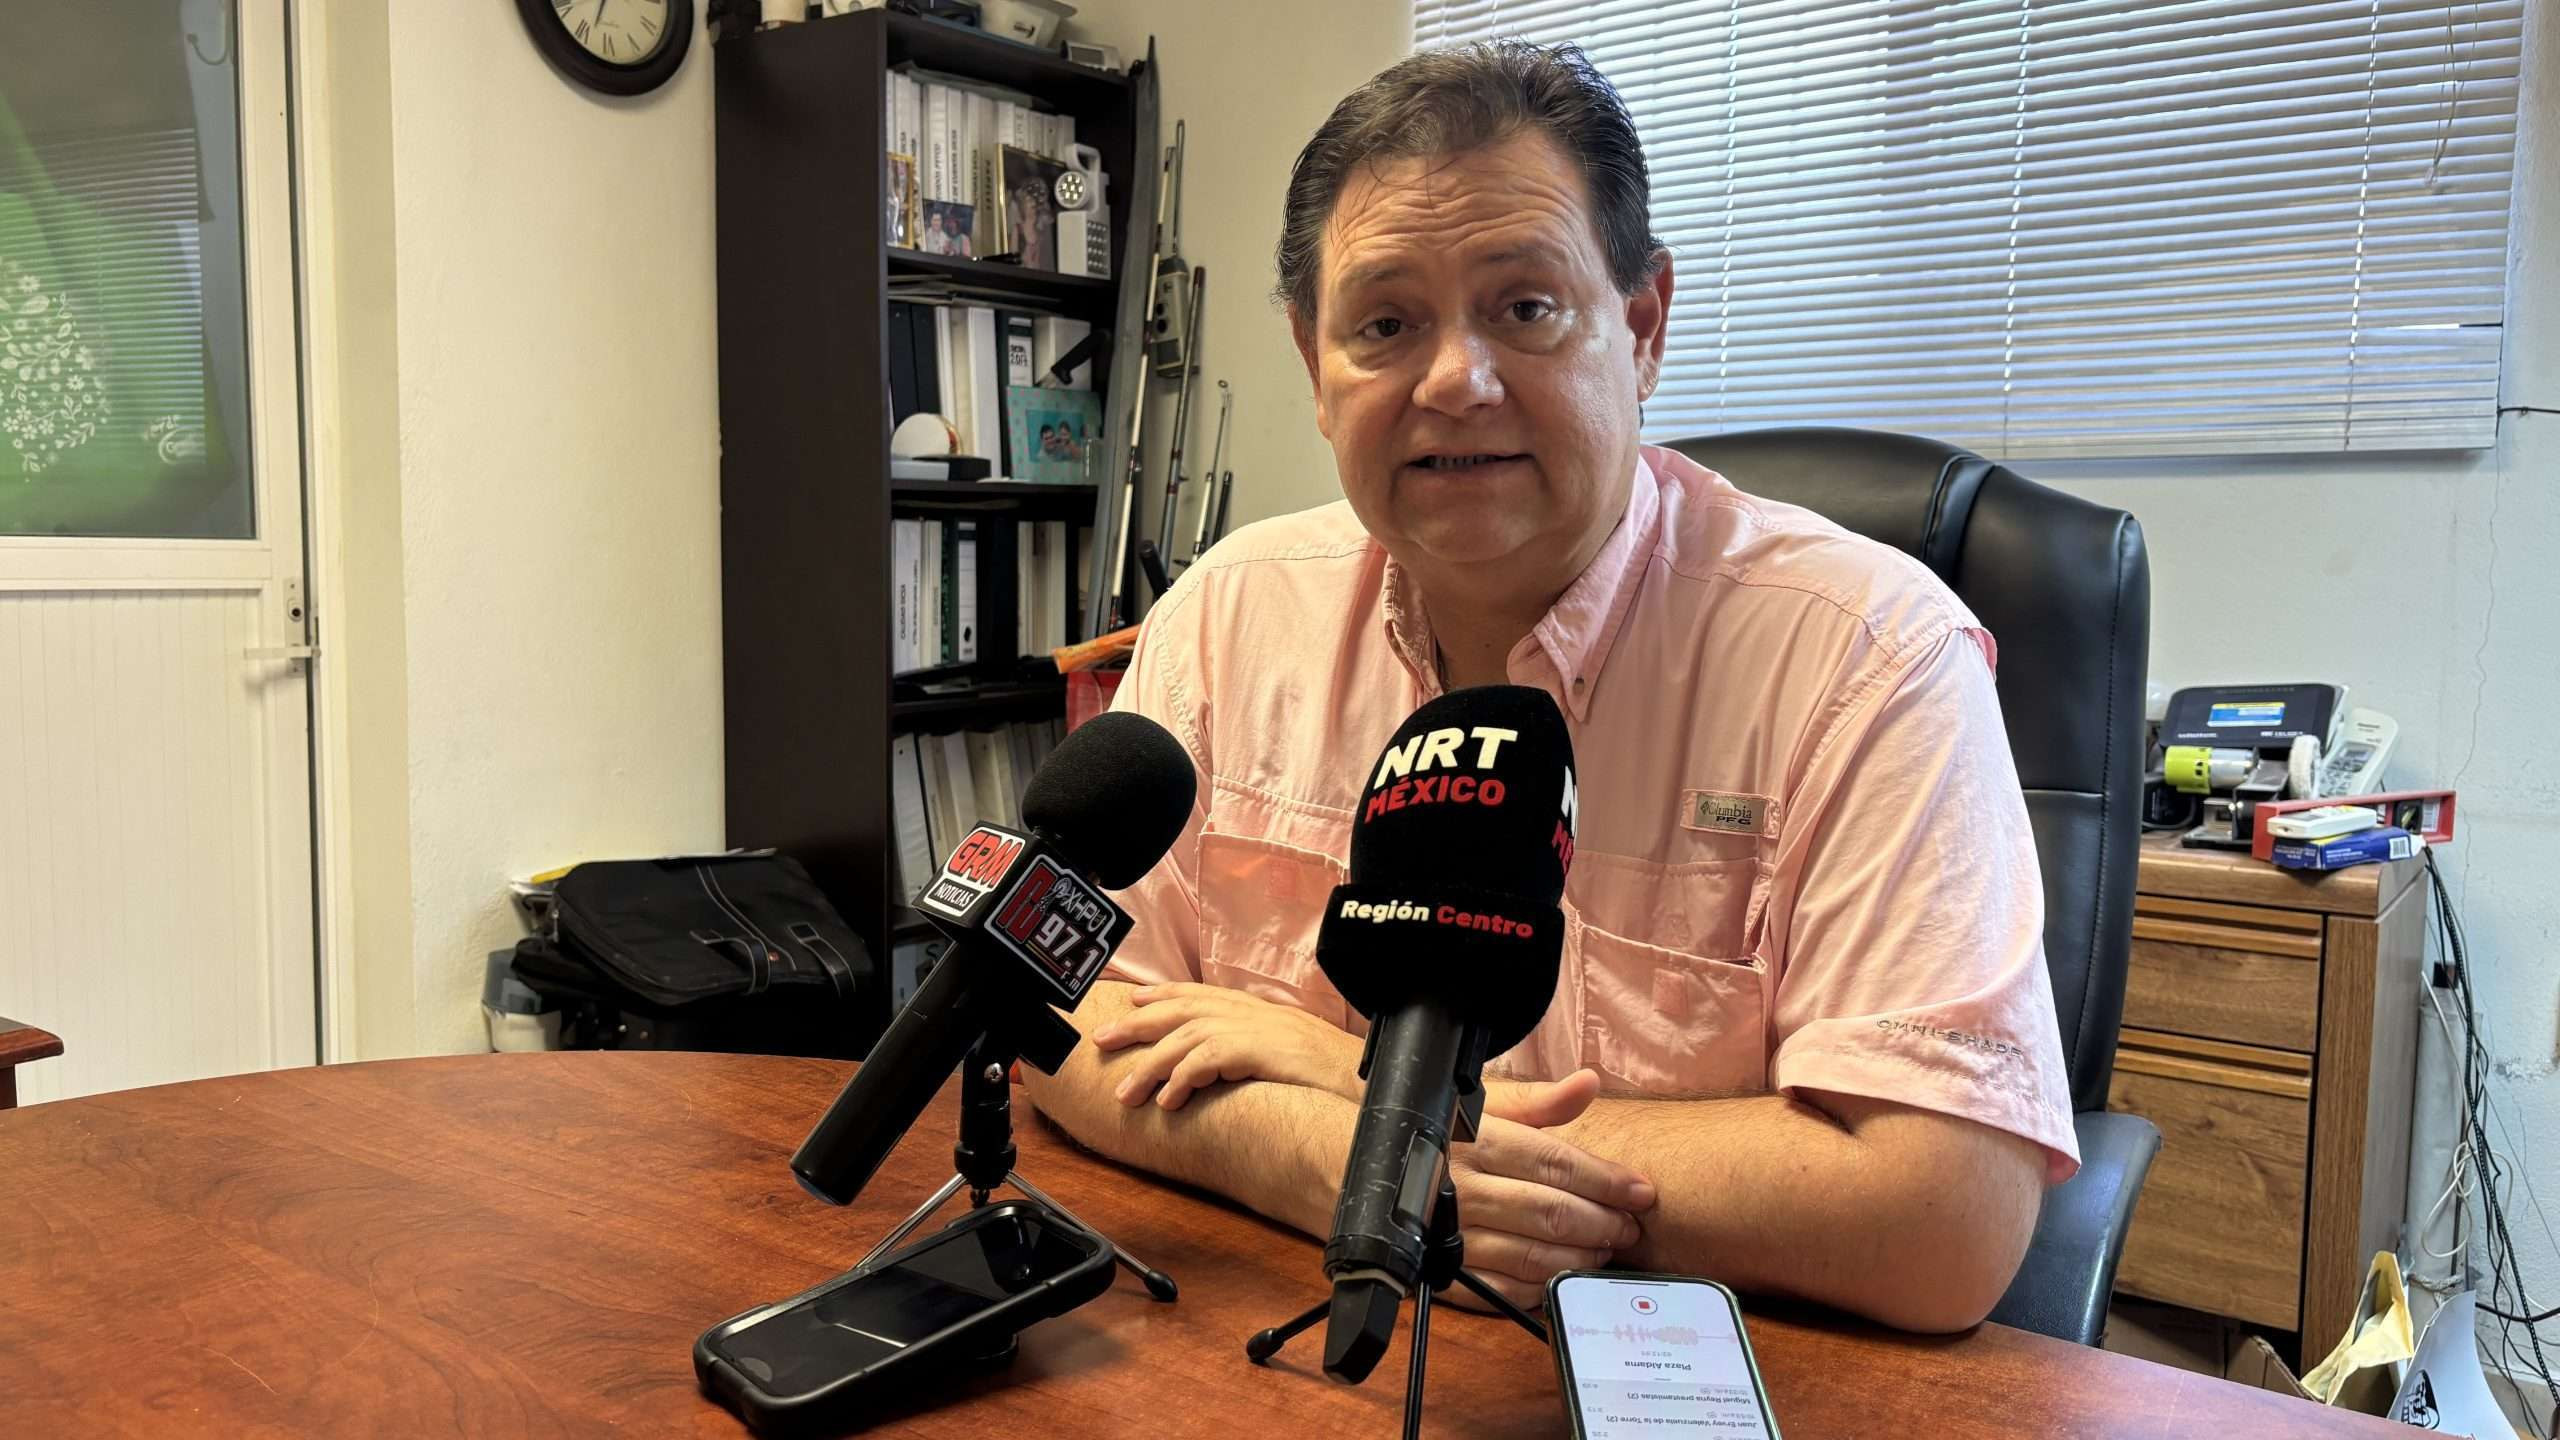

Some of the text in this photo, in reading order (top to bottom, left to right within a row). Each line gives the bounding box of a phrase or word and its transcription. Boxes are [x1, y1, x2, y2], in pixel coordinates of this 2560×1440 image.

[1373, 726, 1518, 790] NRT
[1364, 775, 1506, 824] MÉXICO
[1716, 815, 1751, 825] PFG
[934, 882, 975, 907] NOTICIAS
[1066, 886, 1107, 932] XHPU
[1340, 900, 1534, 938] Región Centro
[1035, 913, 1099, 979] 97.1
[1876, 1019, 2024, 1058] OMNI-SHADE
[1624, 1361, 1692, 1371] Plaza Aldama
[1627, 1391, 1640, 1400] (2)
[1695, 1394, 1721, 1403] Reyna
[1606, 1415, 1619, 1423] (2)
[1620, 1416, 1642, 1424] Torre
[1652, 1417, 1665, 1425] de
[1737, 1420, 1757, 1428] Juan
